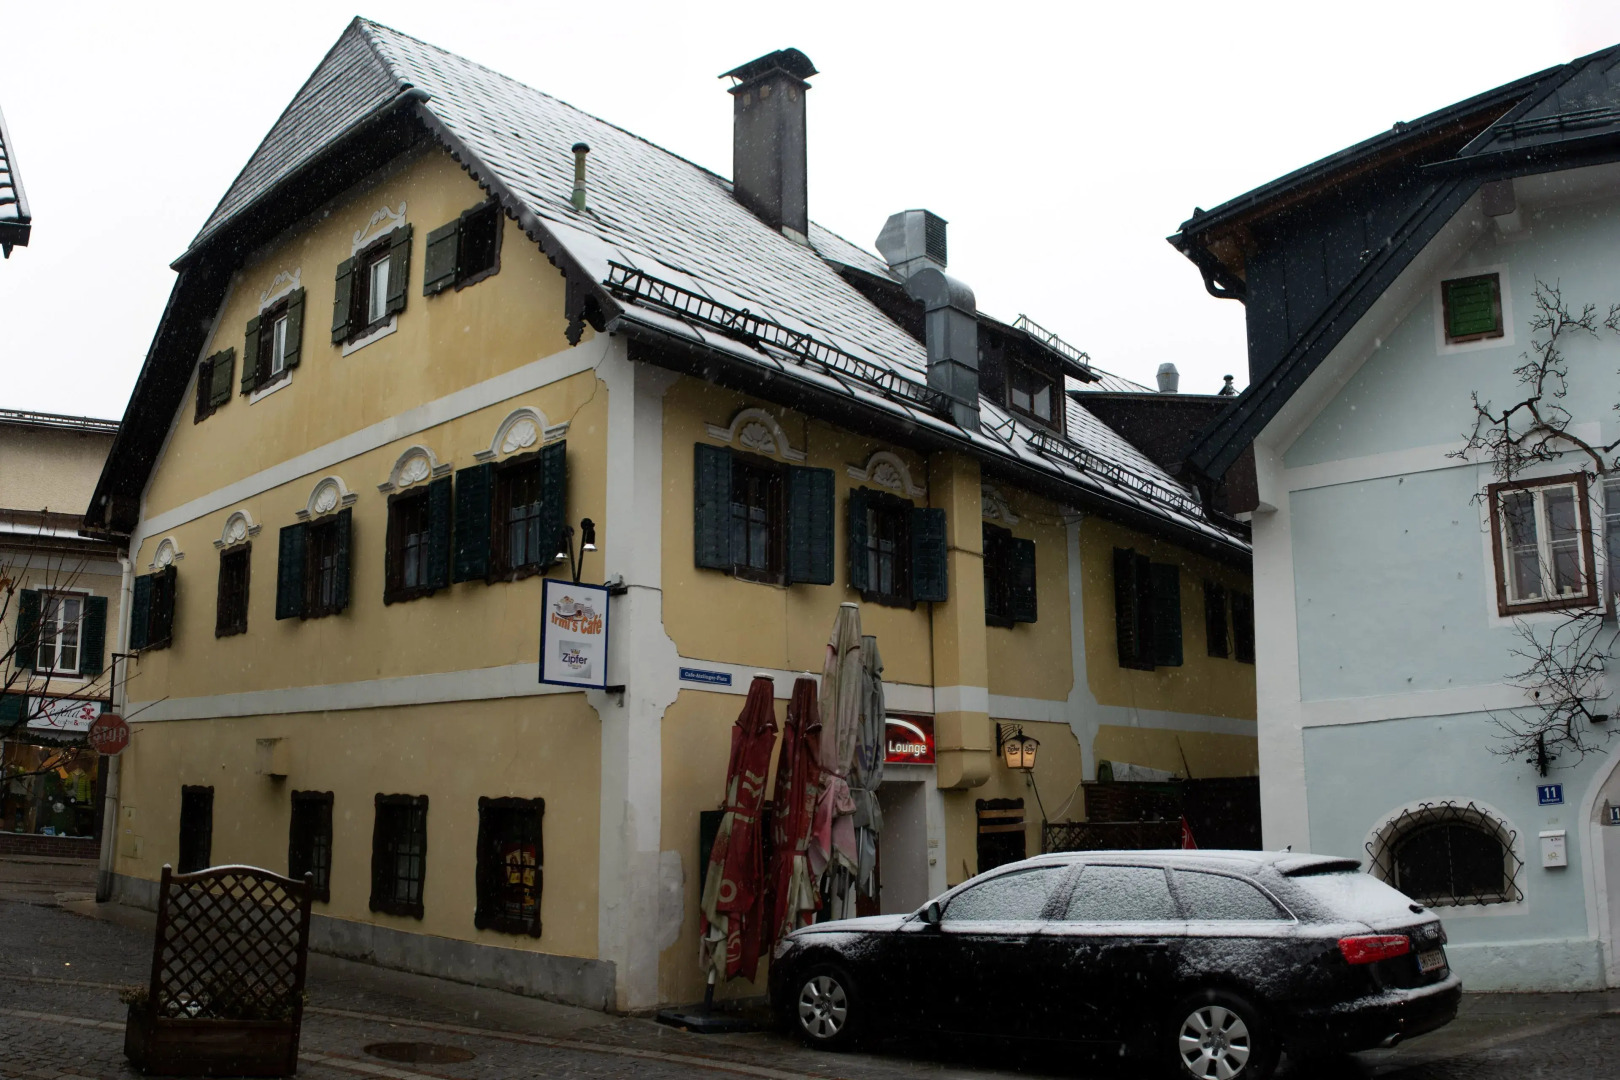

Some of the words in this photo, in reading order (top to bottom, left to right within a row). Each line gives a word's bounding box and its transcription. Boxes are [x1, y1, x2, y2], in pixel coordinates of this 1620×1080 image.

[580, 613, 603, 635] Café
[562, 653, 588, 665] Zipfer
[34, 699, 81, 727] Regina
[92, 725, 127, 743] STOP
[888, 740, 927, 757] Lounge
[1544, 786, 1556, 799] 11
